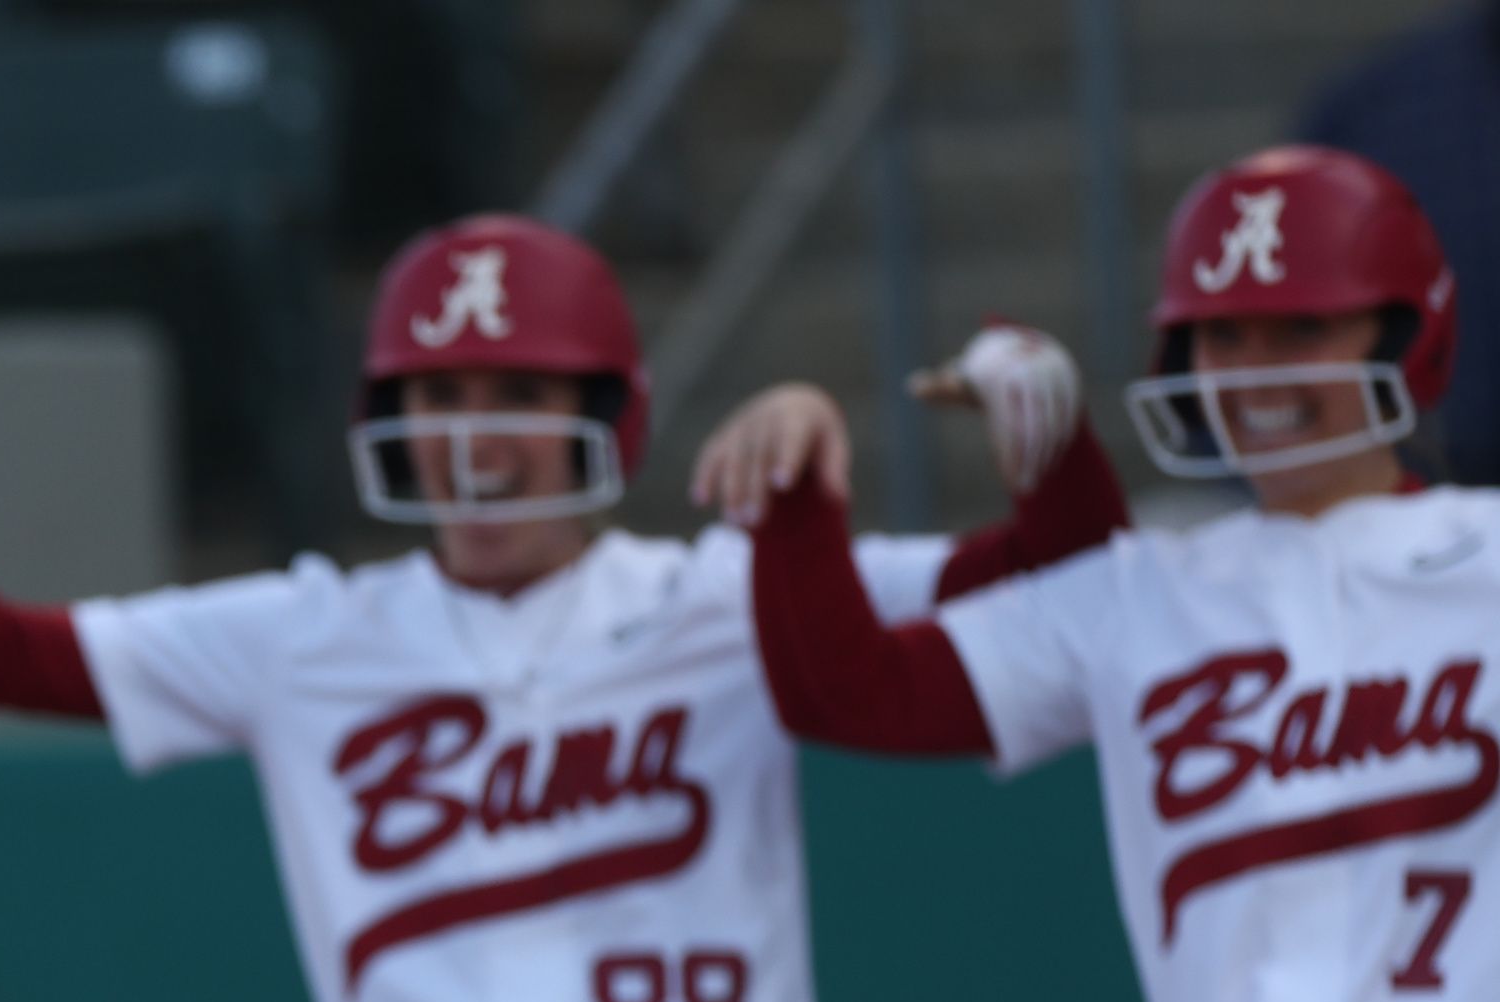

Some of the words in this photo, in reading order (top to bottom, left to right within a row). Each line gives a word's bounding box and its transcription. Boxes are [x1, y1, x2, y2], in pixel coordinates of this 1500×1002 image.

[410, 244, 514, 348] A
[1193, 186, 1285, 293] A
[331, 690, 690, 877] Bama
[1137, 642, 1484, 824] Bama
[1391, 868, 1472, 993] 7
